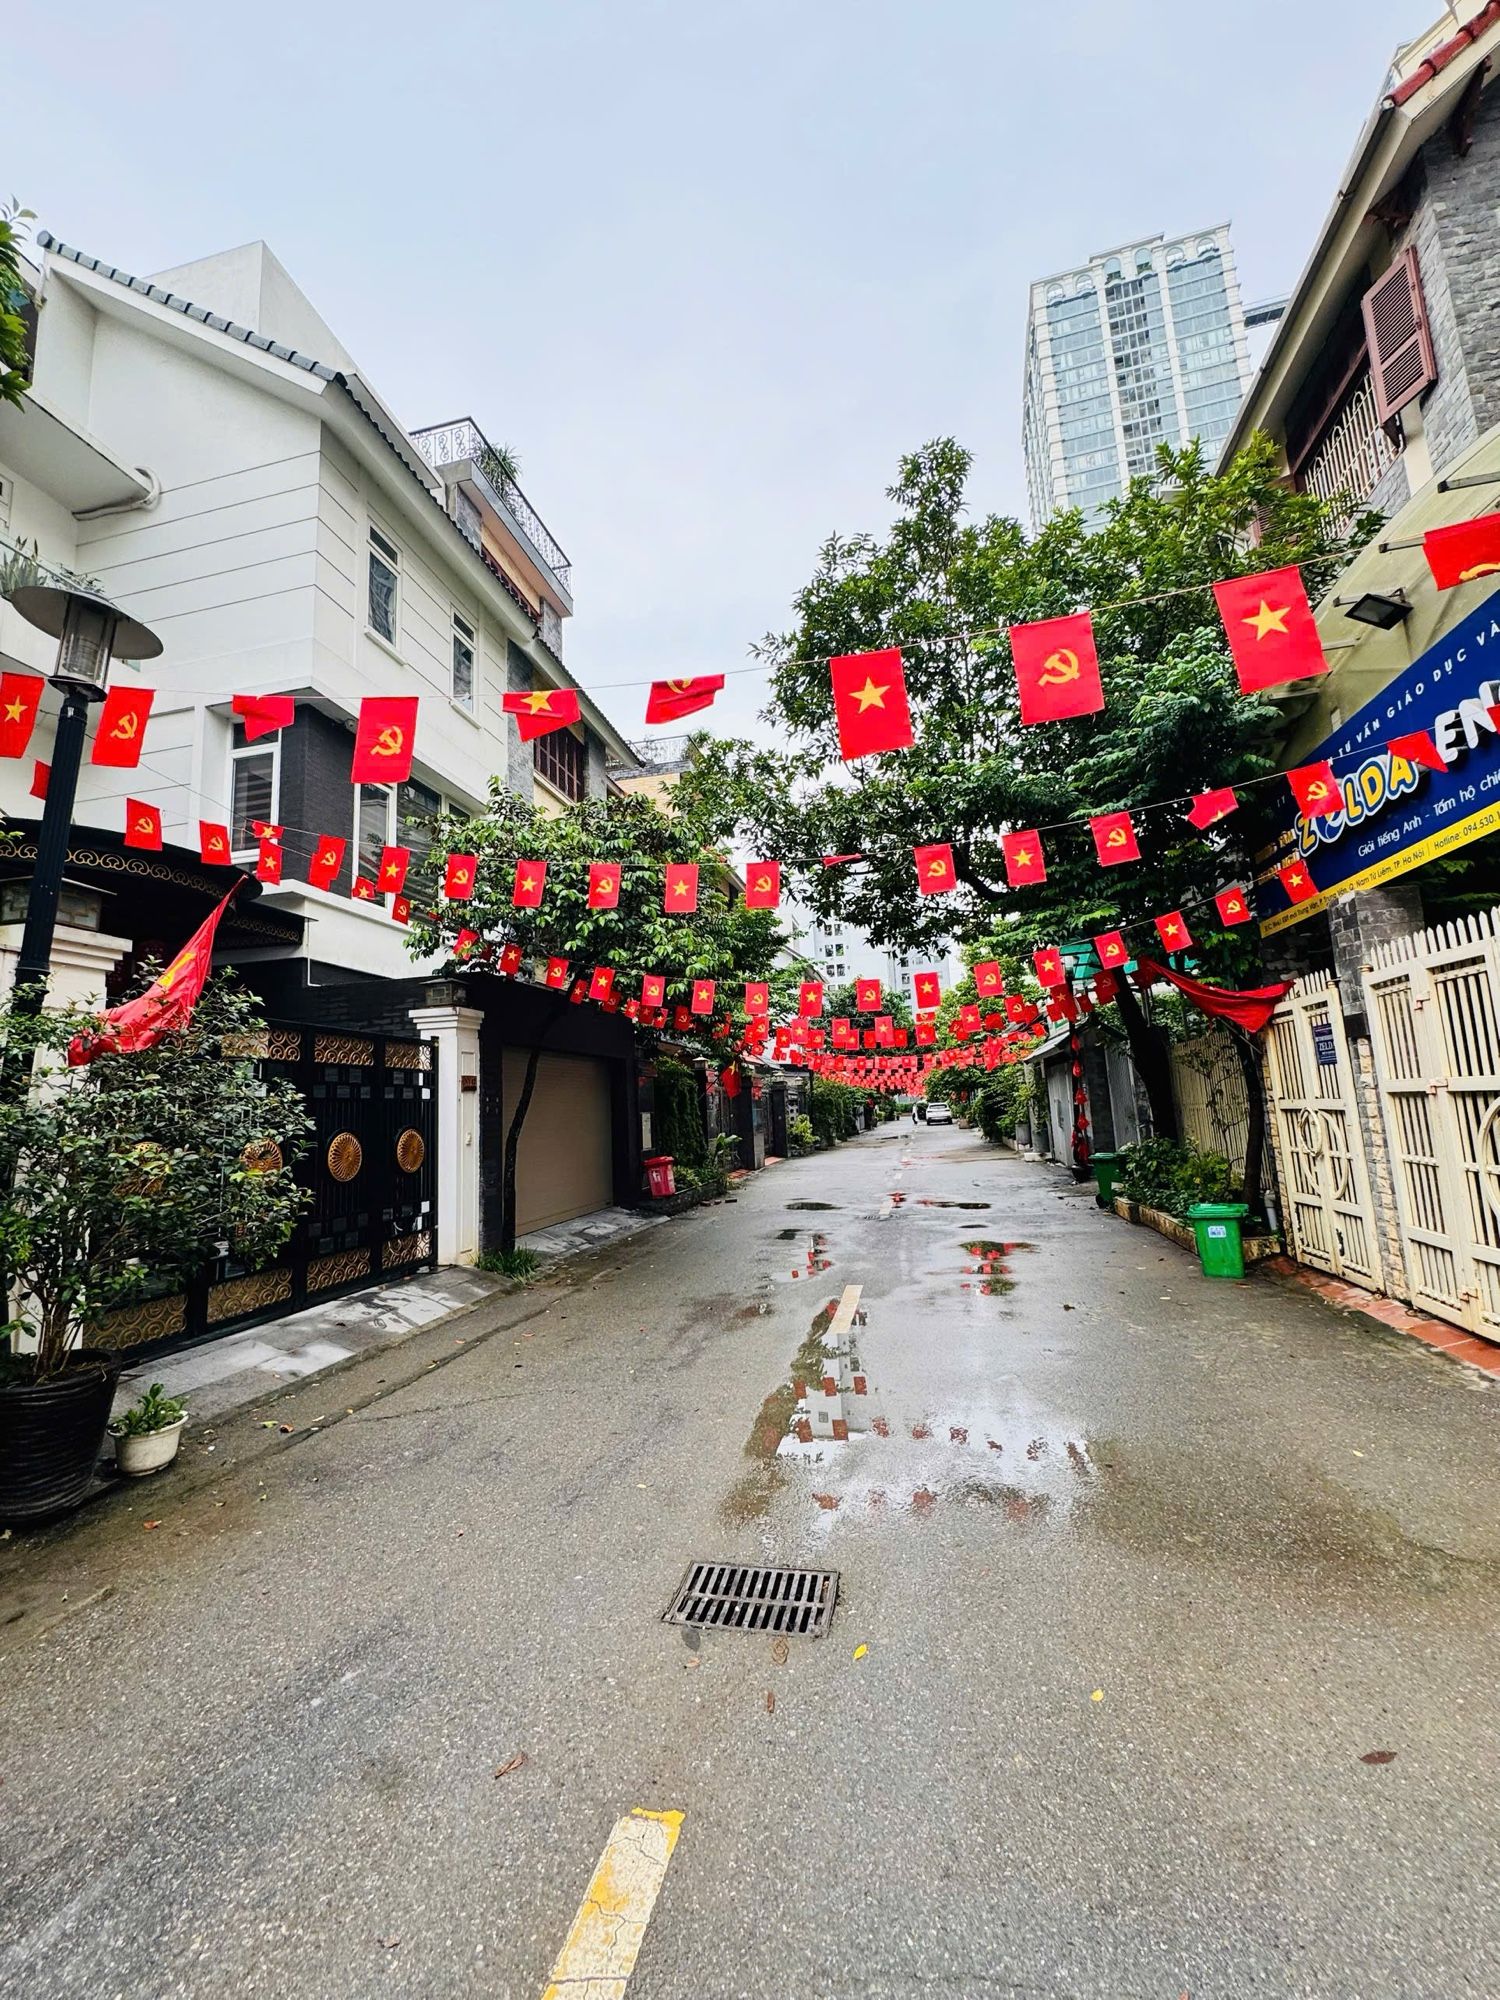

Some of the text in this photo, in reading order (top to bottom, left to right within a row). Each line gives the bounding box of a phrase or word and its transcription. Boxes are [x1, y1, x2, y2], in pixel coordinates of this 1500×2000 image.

[1356, 719, 1381, 743] VẤN
[1387, 683, 1424, 718] GIÁO
[1433, 649, 1467, 682] DỤC
[1434, 680, 1500, 763] EN
[1358, 838, 1376, 857] Giỏi
[1377, 828, 1401, 848] tiếng
[1403, 816, 1423, 835] Anh
[1460, 785, 1476, 803] hộ
